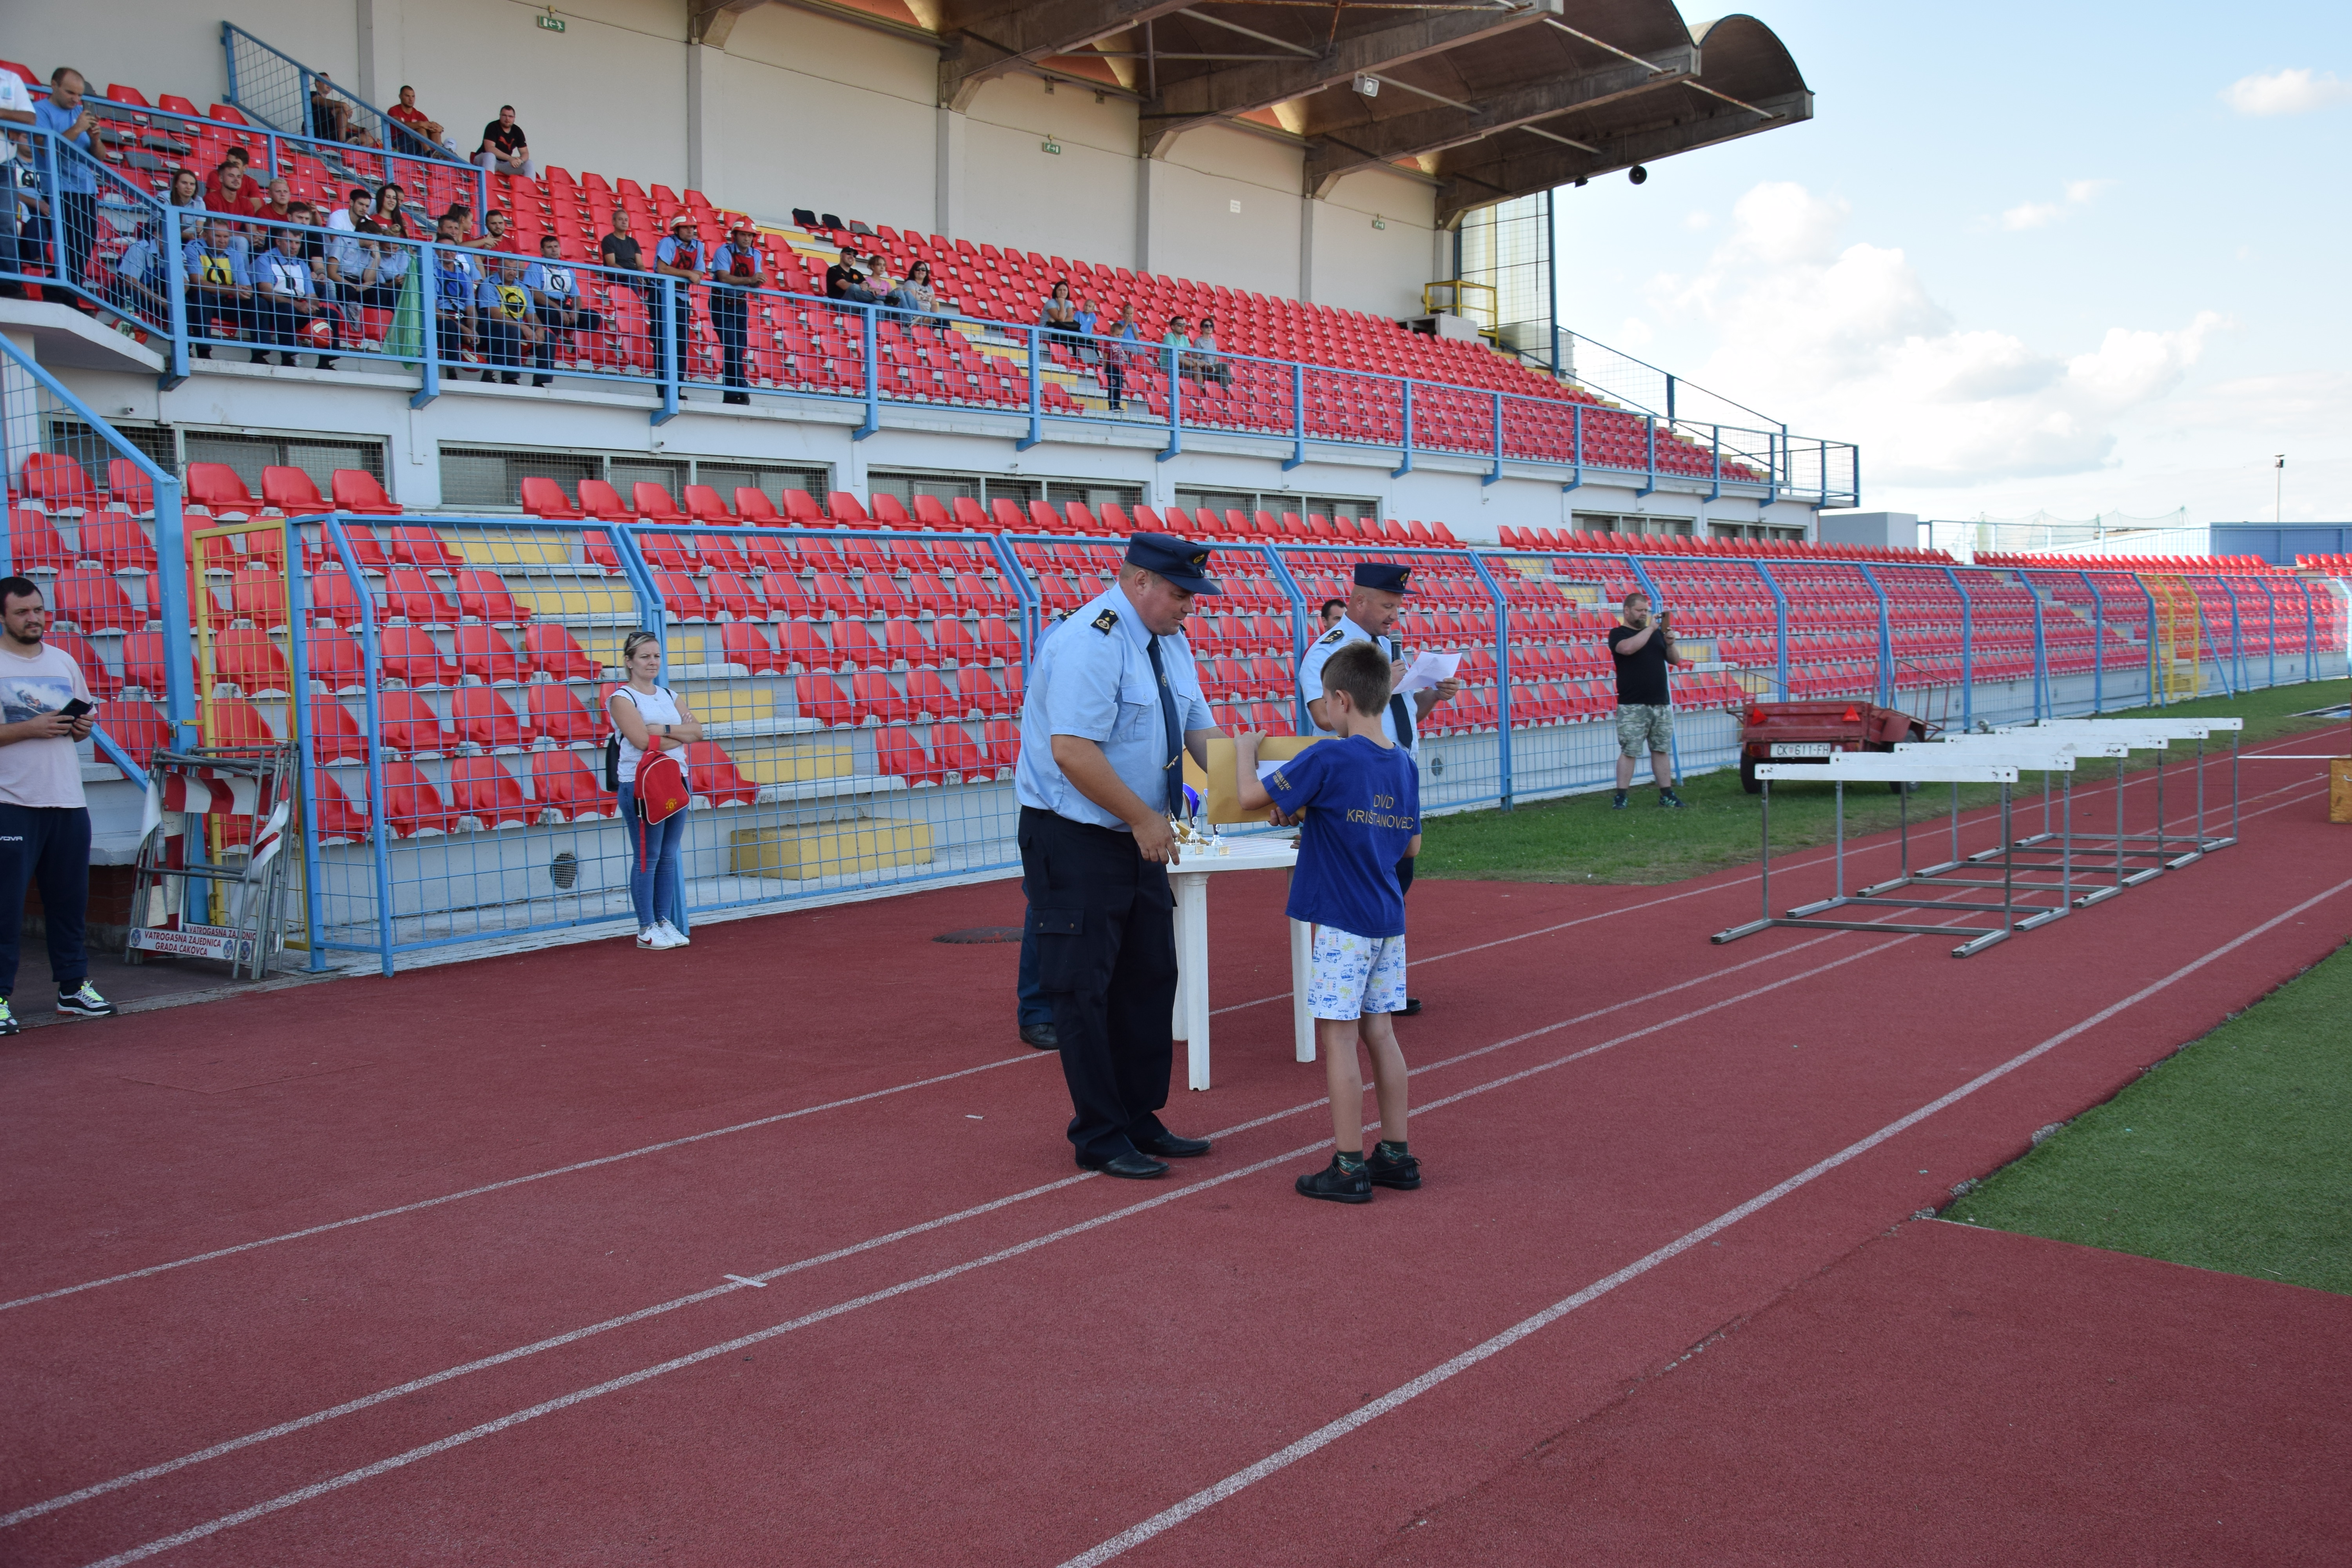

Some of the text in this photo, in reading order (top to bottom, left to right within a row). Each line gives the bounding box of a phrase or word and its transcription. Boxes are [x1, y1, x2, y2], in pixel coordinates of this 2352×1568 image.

[1795, 745, 1829, 755] 611-FH
[1374, 794, 1394, 809] DVD
[1347, 809, 1414, 829] KRIŠTANOVEC
[145, 931, 221, 947] VATROGASNA ZAJEDNICA
[190, 926, 256, 940] VATROGASNA ZADNIC
[155, 942, 207, 956] GRADA ČAKOVCA
